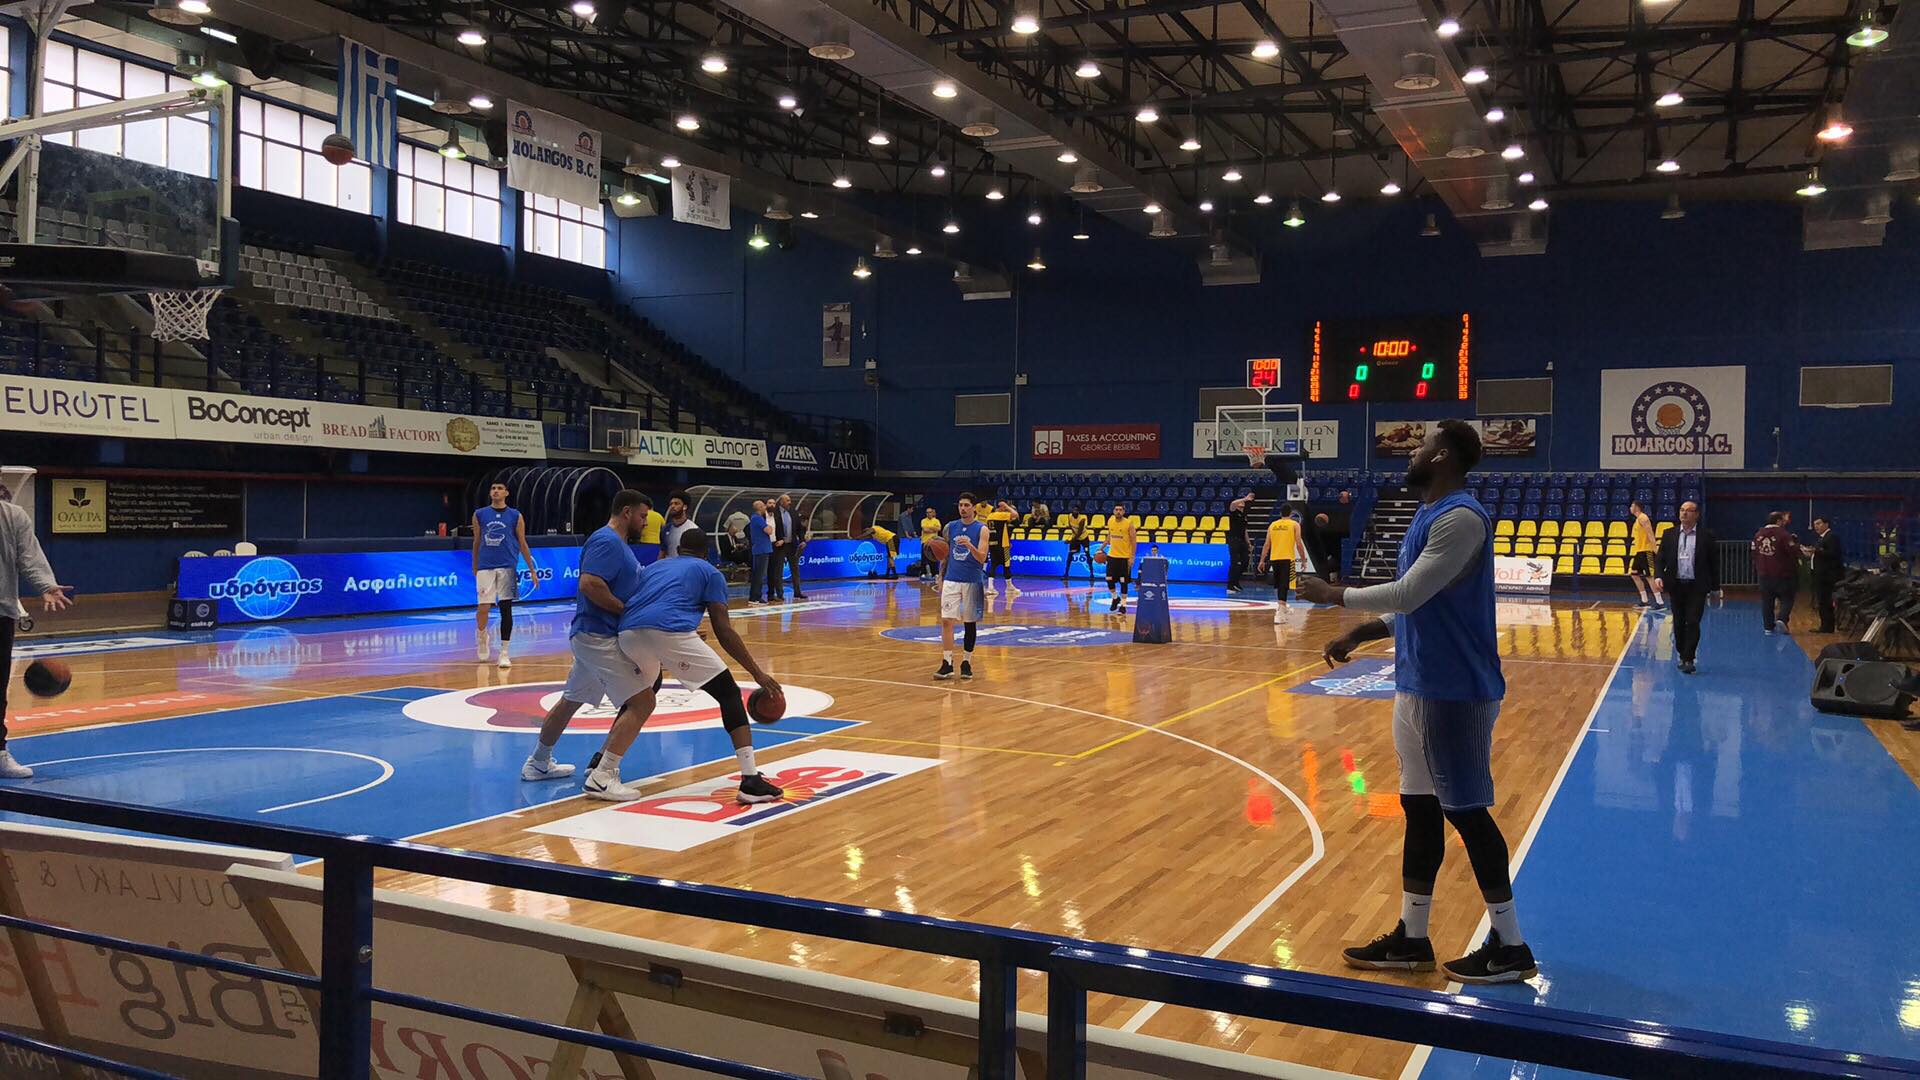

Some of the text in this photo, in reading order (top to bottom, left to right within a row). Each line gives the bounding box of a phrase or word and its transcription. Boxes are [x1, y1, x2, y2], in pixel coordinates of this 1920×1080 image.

[512, 138, 597, 179] HOLARGOS B.C.
[1373, 341, 1410, 356] 10:00
[1253, 360, 1278, 370] 10:00
[1355, 363, 1434, 381] 0 0
[1252, 371, 1275, 386] 24
[1349, 382, 1427, 398] 0 0
[5, 386, 160, 423] EUROTEL
[188, 396, 311, 432] BoConcept
[254, 431, 313, 443] urban design
[323, 423, 367, 437] BREAD
[389, 428, 443, 442] FACTORY
[1066, 433, 1156, 442] TAXES & ACCOUNTING
[640, 436, 694, 457] ALTION
[705, 439, 760, 456] almora
[1036, 441, 1061, 455] GB
[1614, 436, 1730, 453] HOLARGOS B.C.
[779, 445, 814, 461] ARENA
[808, 556, 844, 566] Ασφαλιστική
[1010, 553, 1062, 563] σφαλιστική
[210, 573, 458, 600] υδρόγειος Ασφαλιστική
